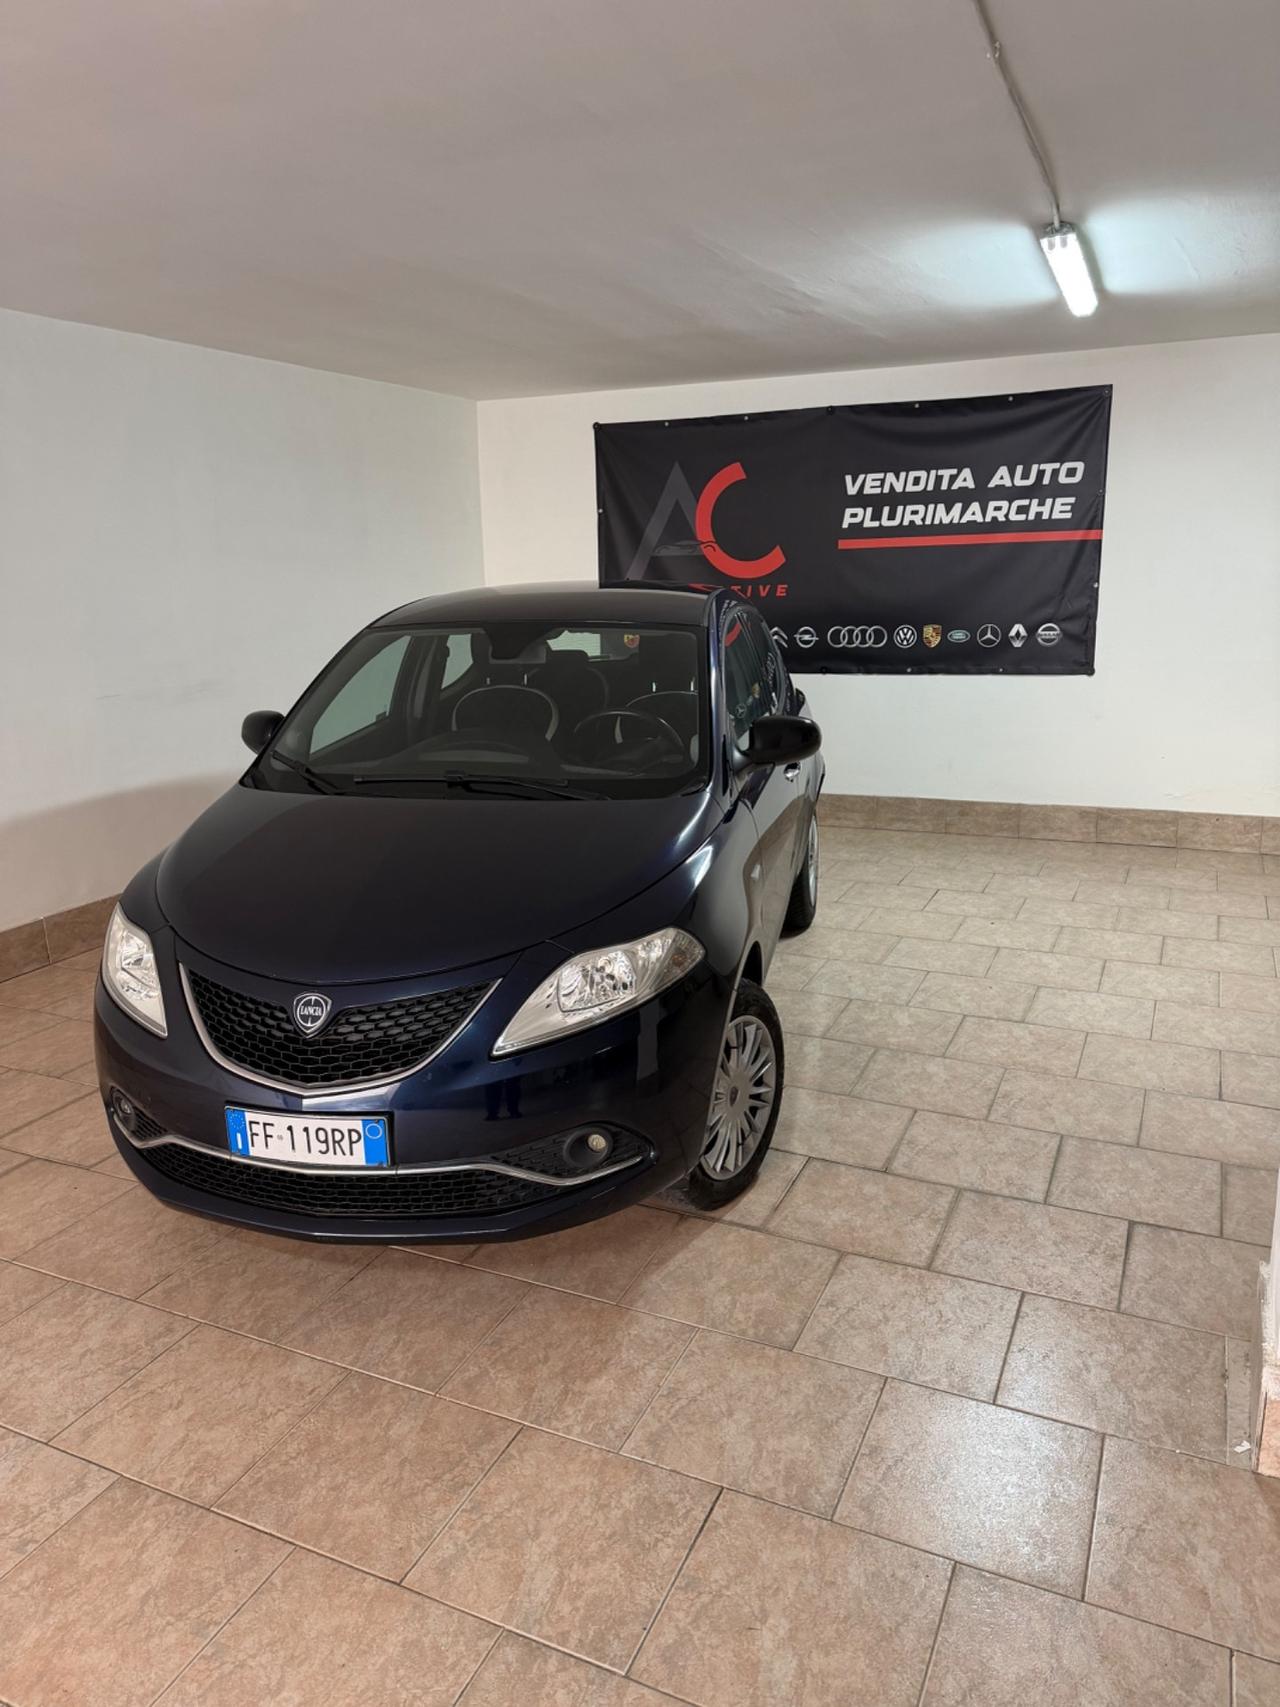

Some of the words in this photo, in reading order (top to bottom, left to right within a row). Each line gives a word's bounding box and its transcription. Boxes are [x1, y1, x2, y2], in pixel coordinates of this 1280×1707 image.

[844, 467, 976, 496] VENDITA
[987, 460, 1085, 489] AUTO
[841, 496, 1076, 529] PLURIMARCHE
